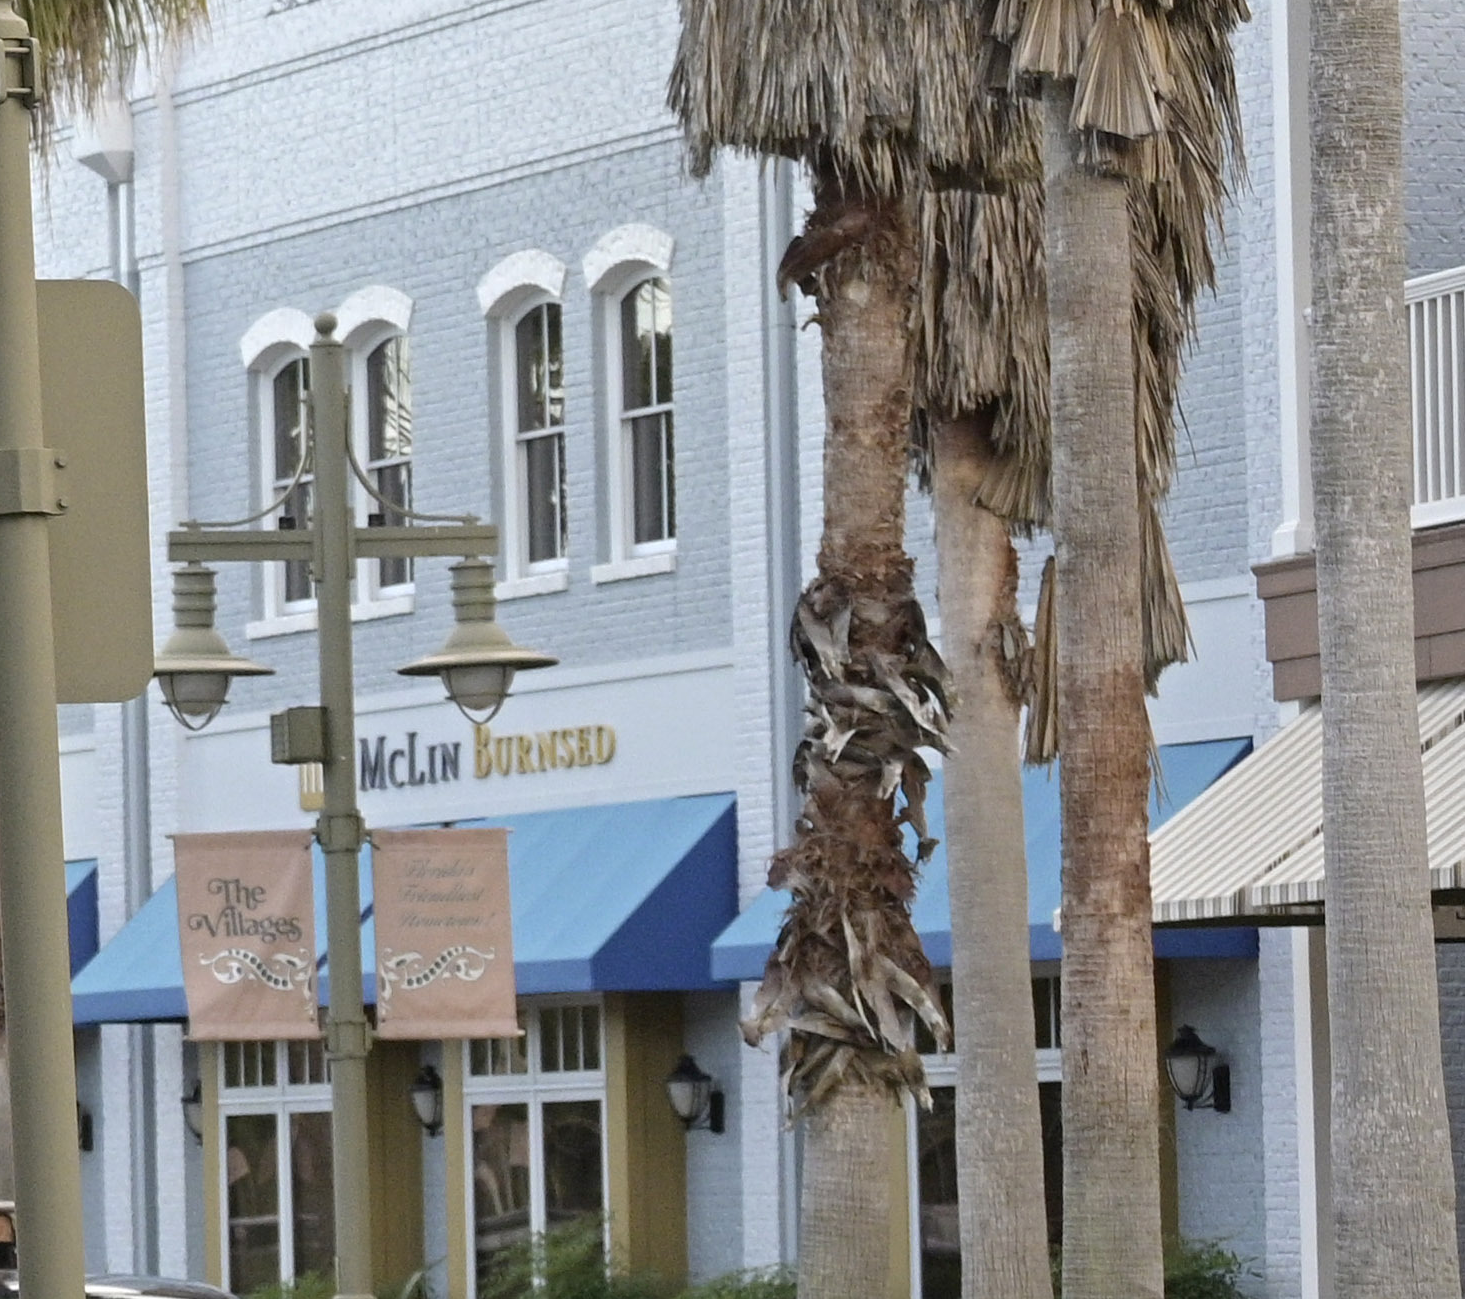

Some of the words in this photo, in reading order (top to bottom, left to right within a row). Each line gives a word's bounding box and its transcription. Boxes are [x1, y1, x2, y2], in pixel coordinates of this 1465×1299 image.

[472, 723, 617, 780] BURNSED
[207, 877, 267, 910] The
[188, 906, 303, 945] Villages
